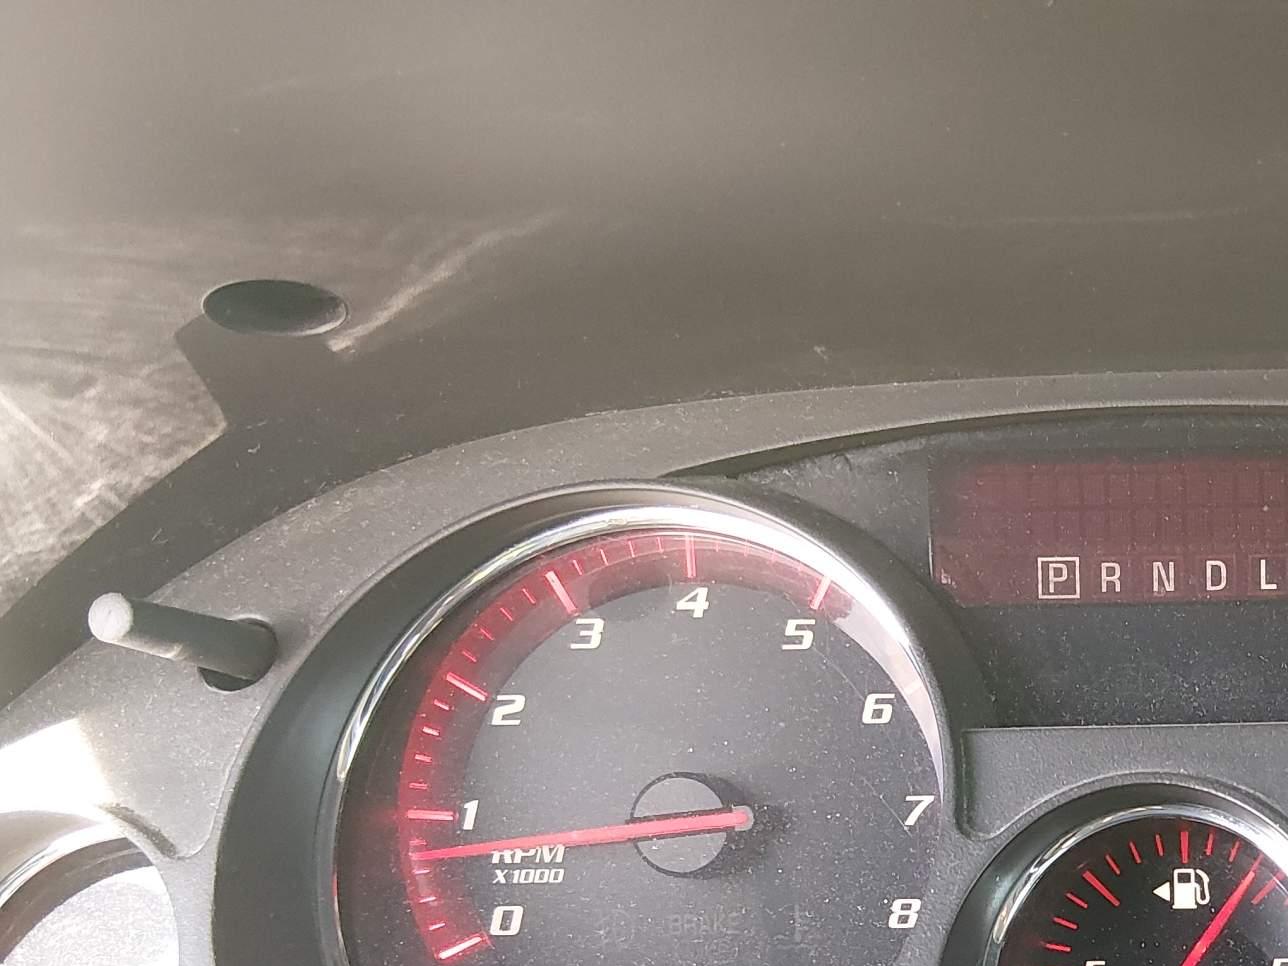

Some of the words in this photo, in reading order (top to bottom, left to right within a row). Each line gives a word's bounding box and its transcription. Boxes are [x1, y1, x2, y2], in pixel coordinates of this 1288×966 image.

[1047, 562, 1069, 592] P
[1101, 562, 1121, 593] R
[1152, 561, 1175, 592] N
[1206, 560, 1227, 591] D
[1260, 559, 1278, 590] L
[676, 587, 710, 618] 4
[570, 617, 605, 650] 3
[781, 618, 816, 650] 5
[491, 694, 526, 726] 2
[861, 693, 896, 724] 6
[462, 799, 479, 830] 1
[904, 795, 935, 826] 7
[490, 843, 565, 864] RPM
[489, 905, 524, 936] 0
[888, 898, 922, 929] 8
